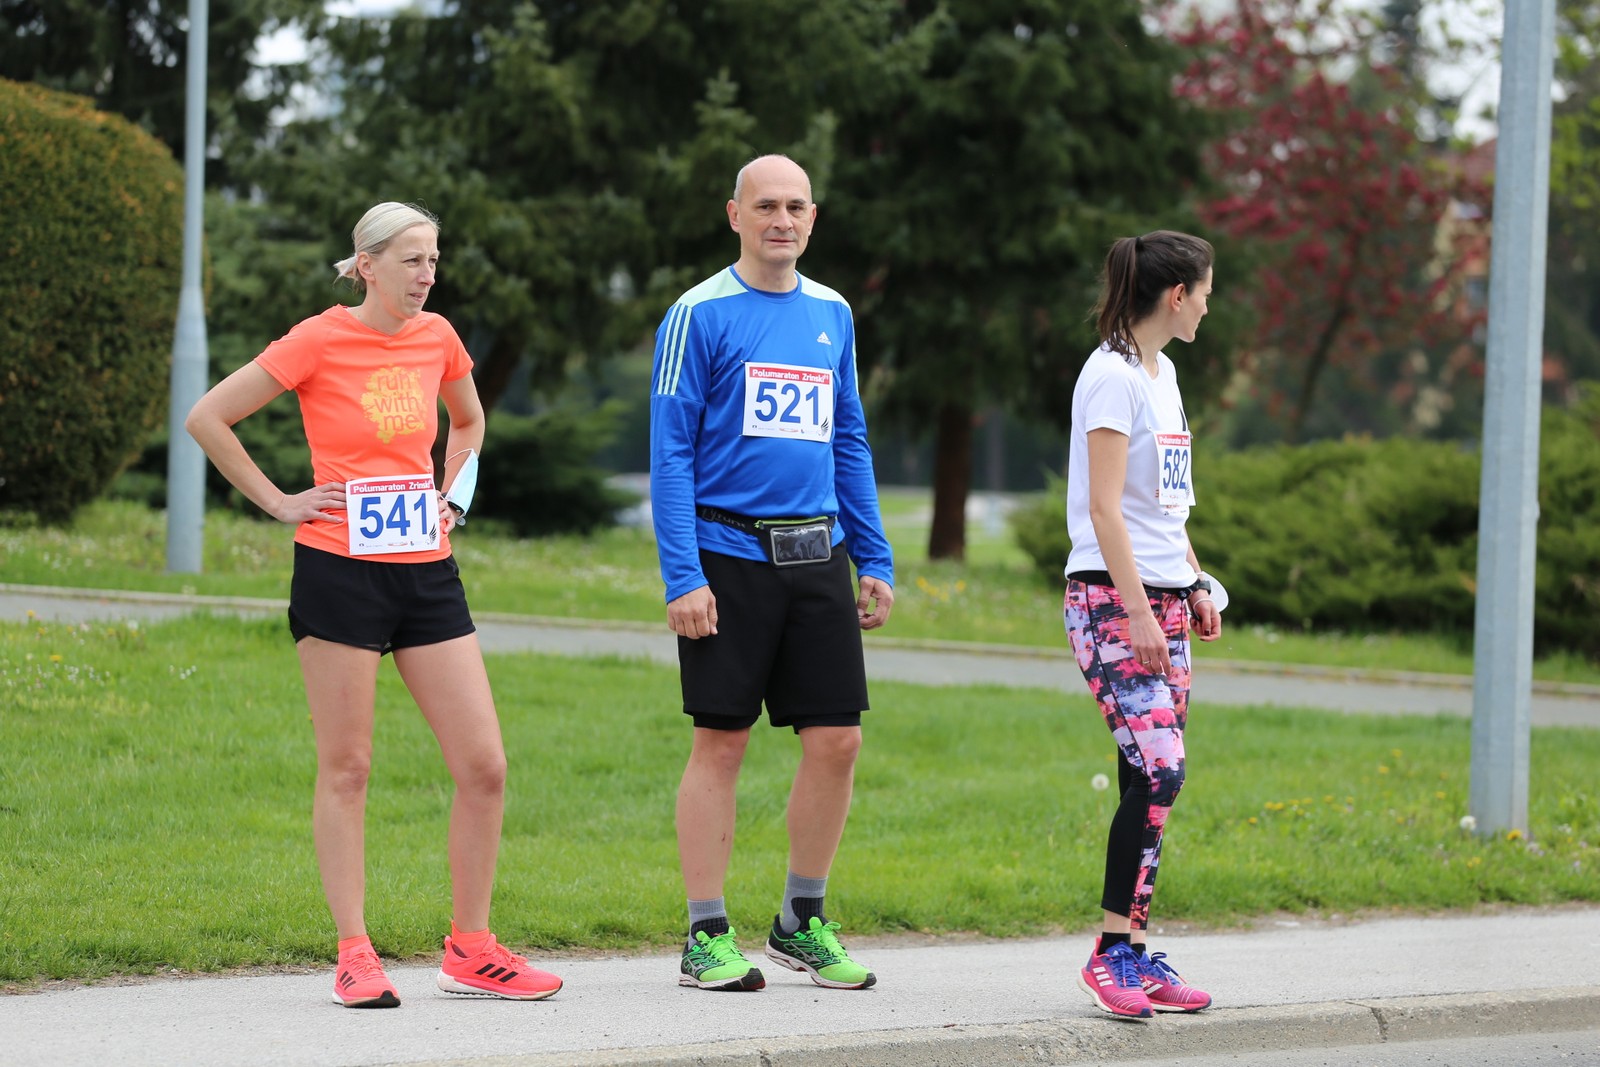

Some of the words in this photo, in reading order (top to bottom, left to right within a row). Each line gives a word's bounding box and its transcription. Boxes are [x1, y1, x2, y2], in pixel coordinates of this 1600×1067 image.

[377, 374, 412, 391] run
[752, 369, 799, 380] Polumaraton
[374, 392, 419, 413] with
[755, 381, 819, 425] 521
[383, 414, 420, 431] me
[1163, 449, 1188, 489] 582
[353, 483, 405, 493] Polumaraton
[360, 493, 427, 539] 541
